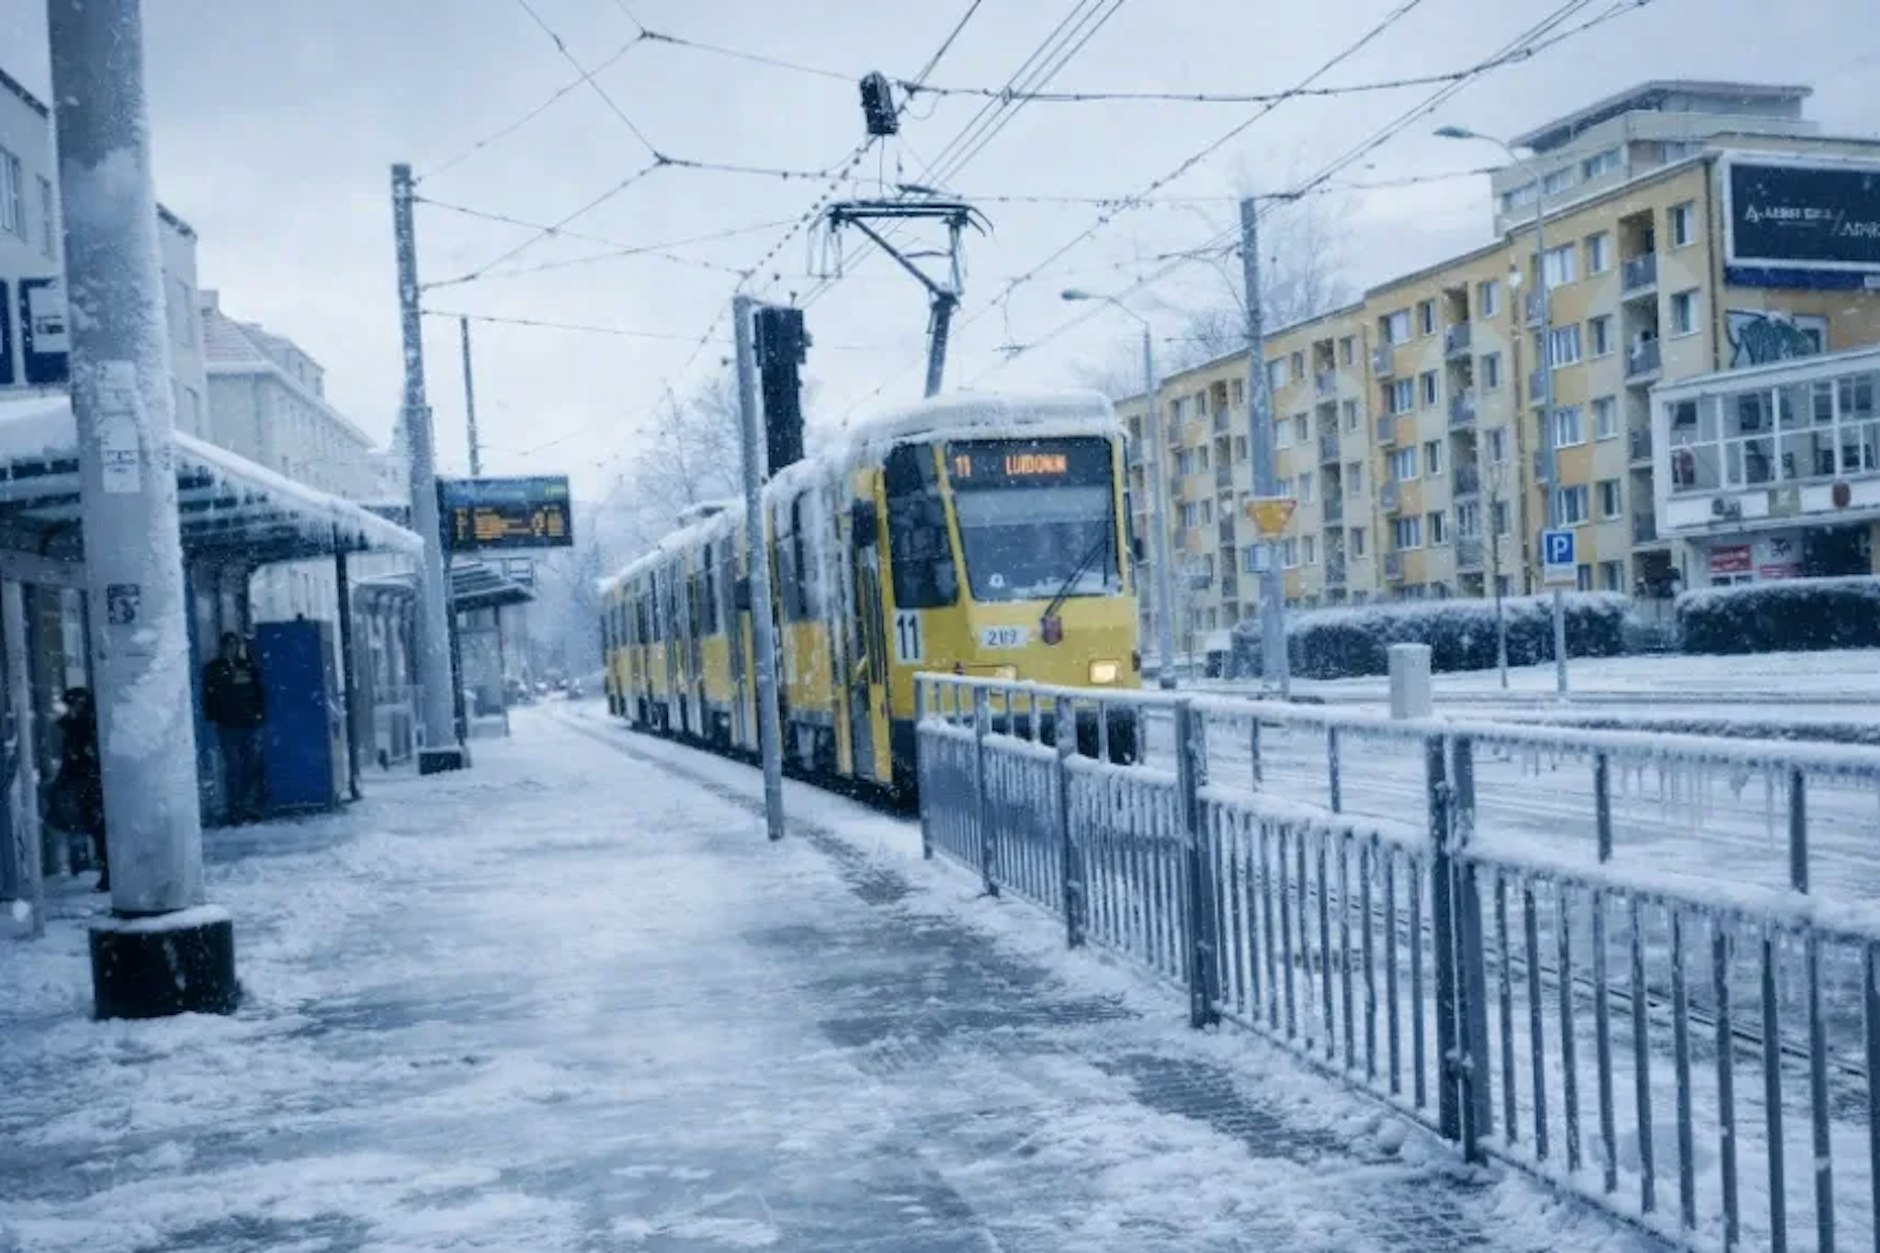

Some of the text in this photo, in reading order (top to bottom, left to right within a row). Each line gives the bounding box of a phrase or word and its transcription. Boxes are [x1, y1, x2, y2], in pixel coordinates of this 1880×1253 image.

[955, 455, 971, 477] 11
[1552, 536, 1568, 562] P
[897, 614, 919, 660] 11
